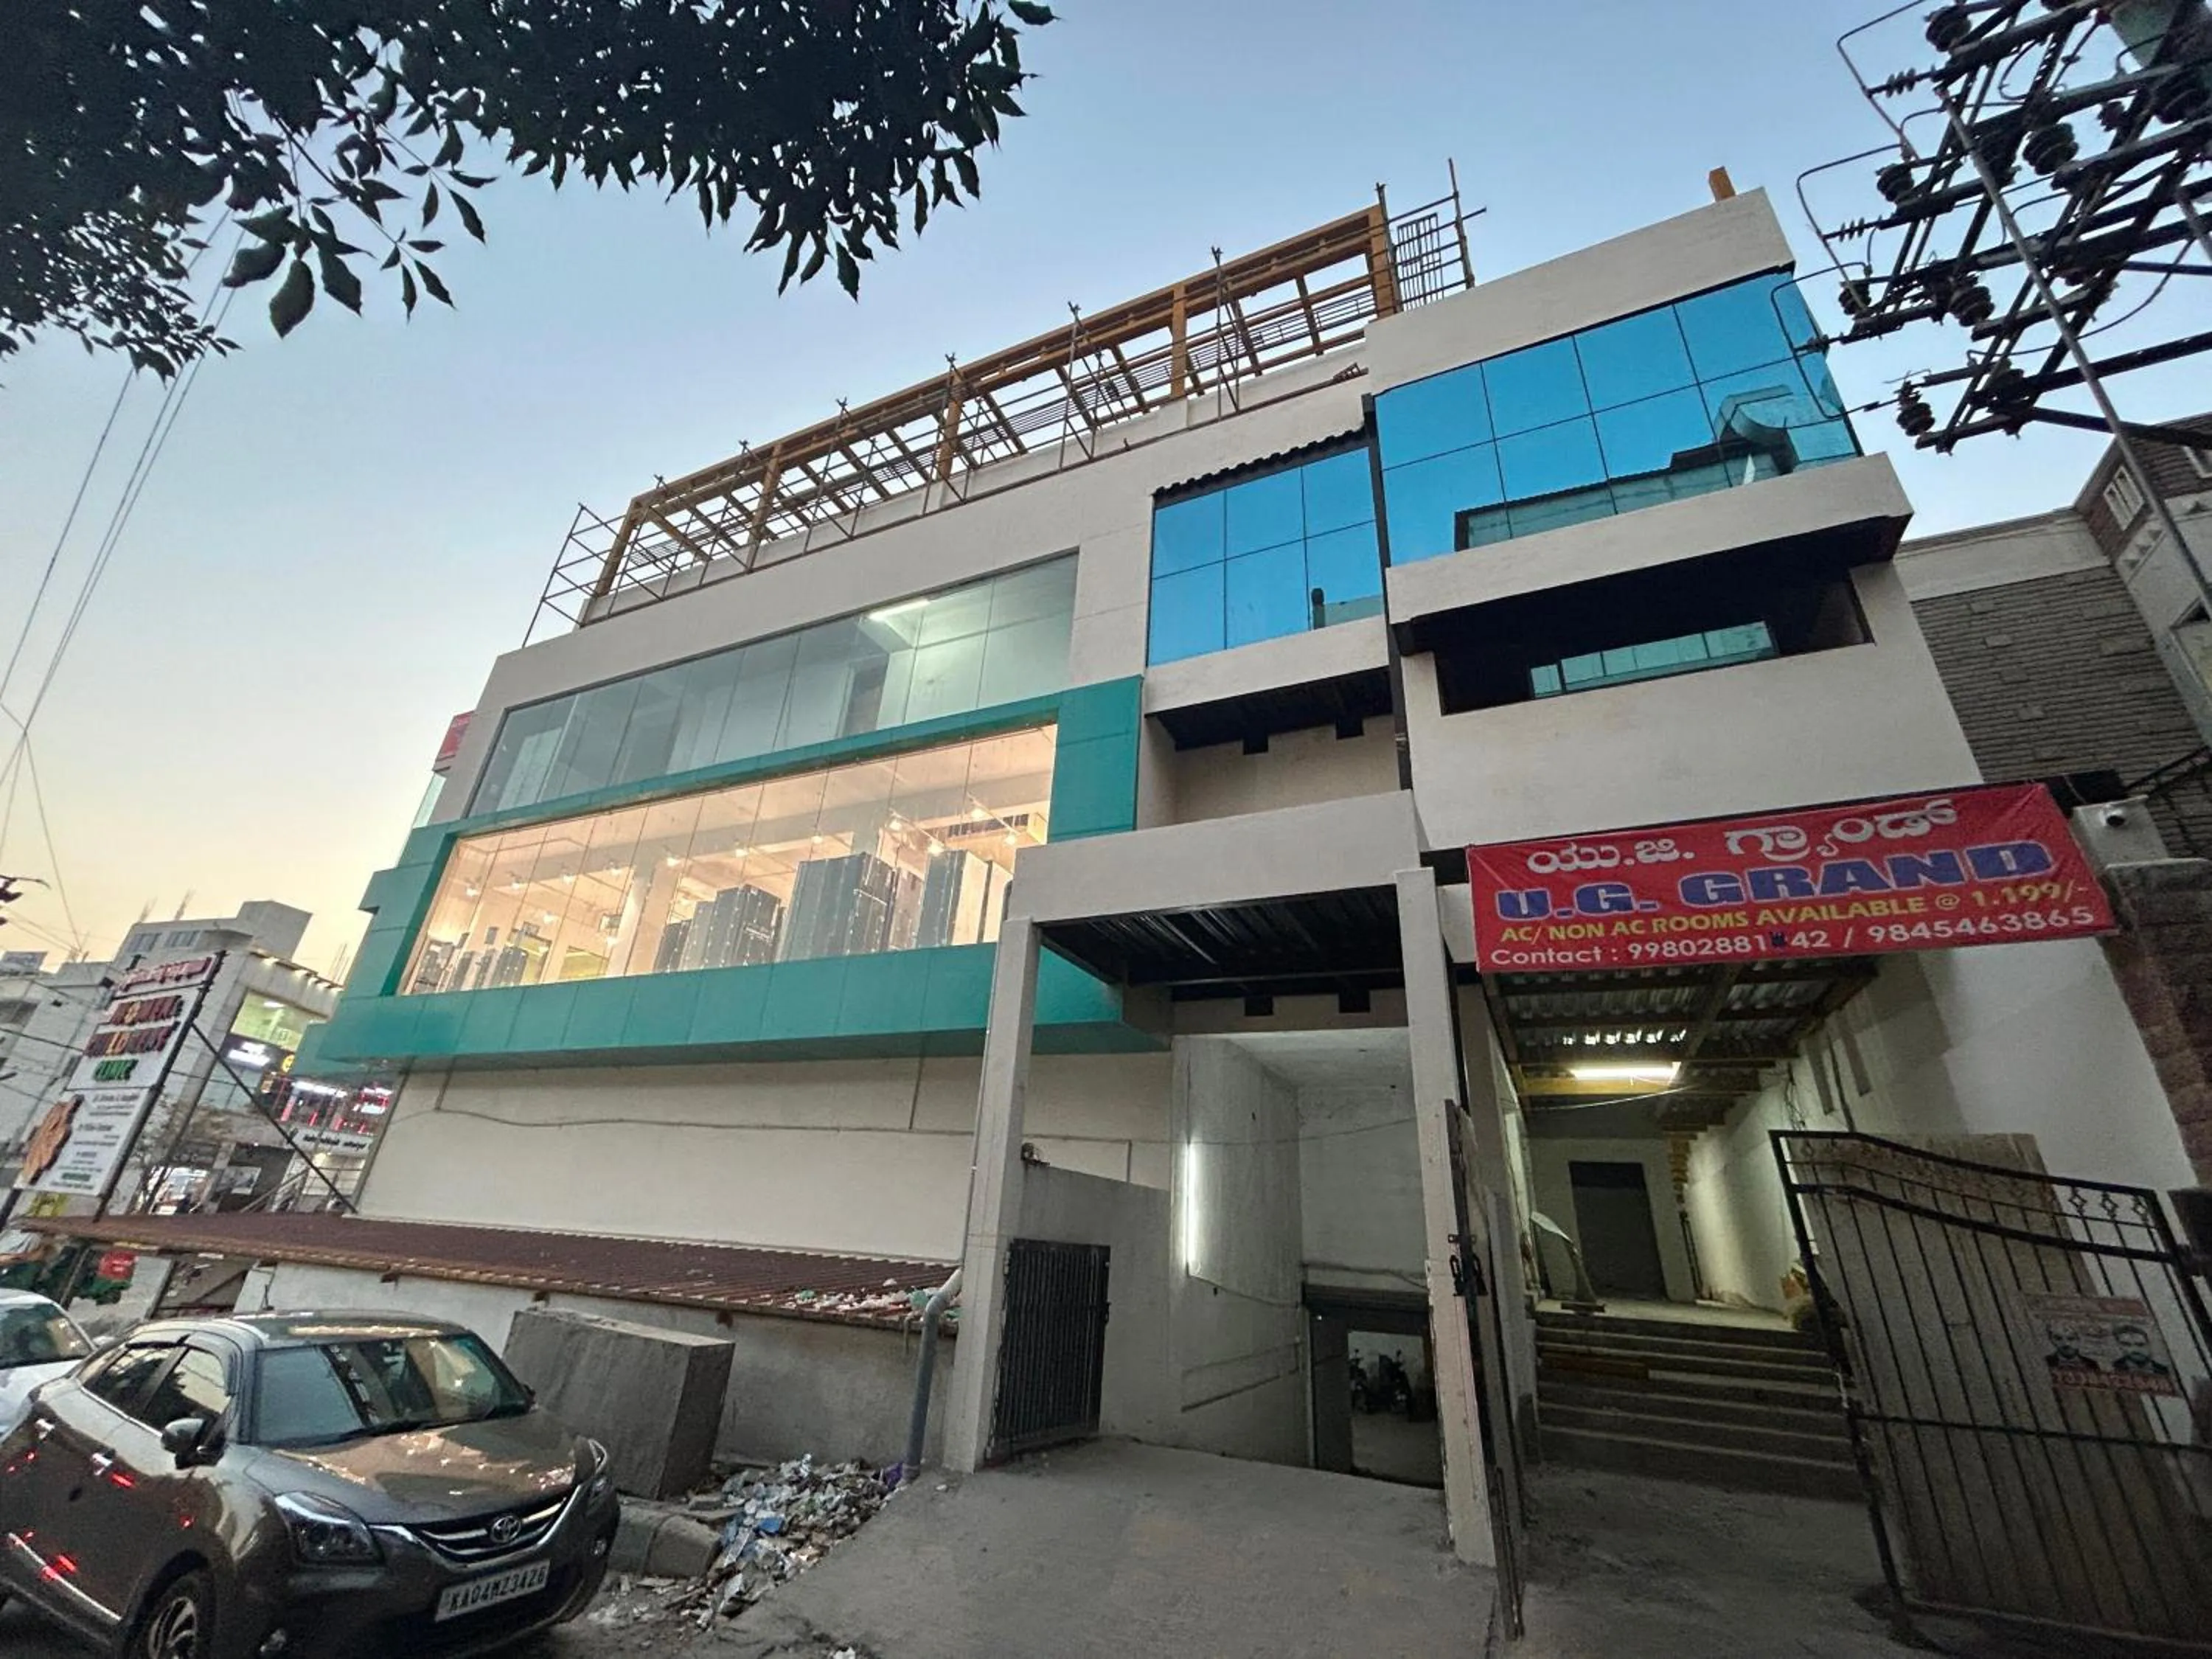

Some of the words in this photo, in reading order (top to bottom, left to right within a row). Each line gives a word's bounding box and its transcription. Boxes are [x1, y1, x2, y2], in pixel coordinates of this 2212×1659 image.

[1495, 881, 1660, 921] U.G.
[1678, 840, 2056, 908] GRAND
[1610, 918, 1648, 936] AC
[1652, 913, 1749, 934] ROOMS
[1756, 895, 1927, 927] AVAILABLE
[1934, 893, 1961, 911] @
[1867, 906, 2096, 944] 9845463865
